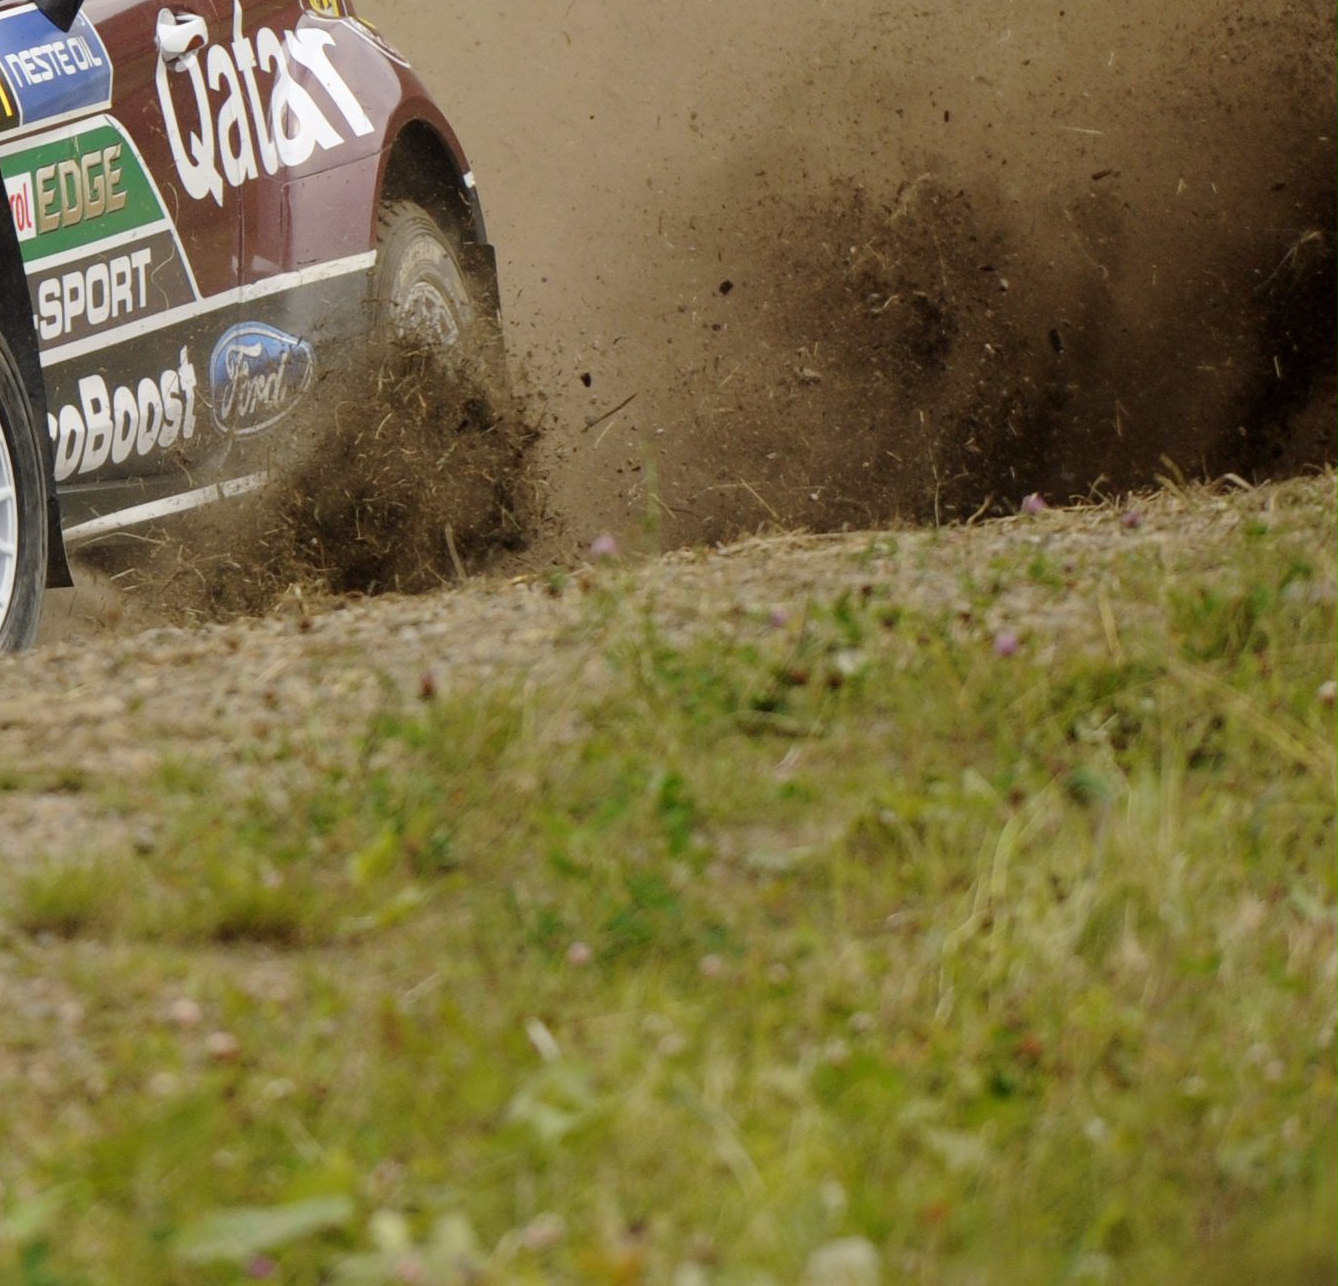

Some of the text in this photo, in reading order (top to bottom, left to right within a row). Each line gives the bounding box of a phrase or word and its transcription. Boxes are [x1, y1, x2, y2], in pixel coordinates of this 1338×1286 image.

[4, 41, 77, 88] NESTE
[66, 35, 103, 72] OIL
[36, 143, 128, 234] EDGE
[33, 247, 152, 341] -SPORT
[48, 345, 197, 482] oBoost
[221, 343, 289, 420] Ford
